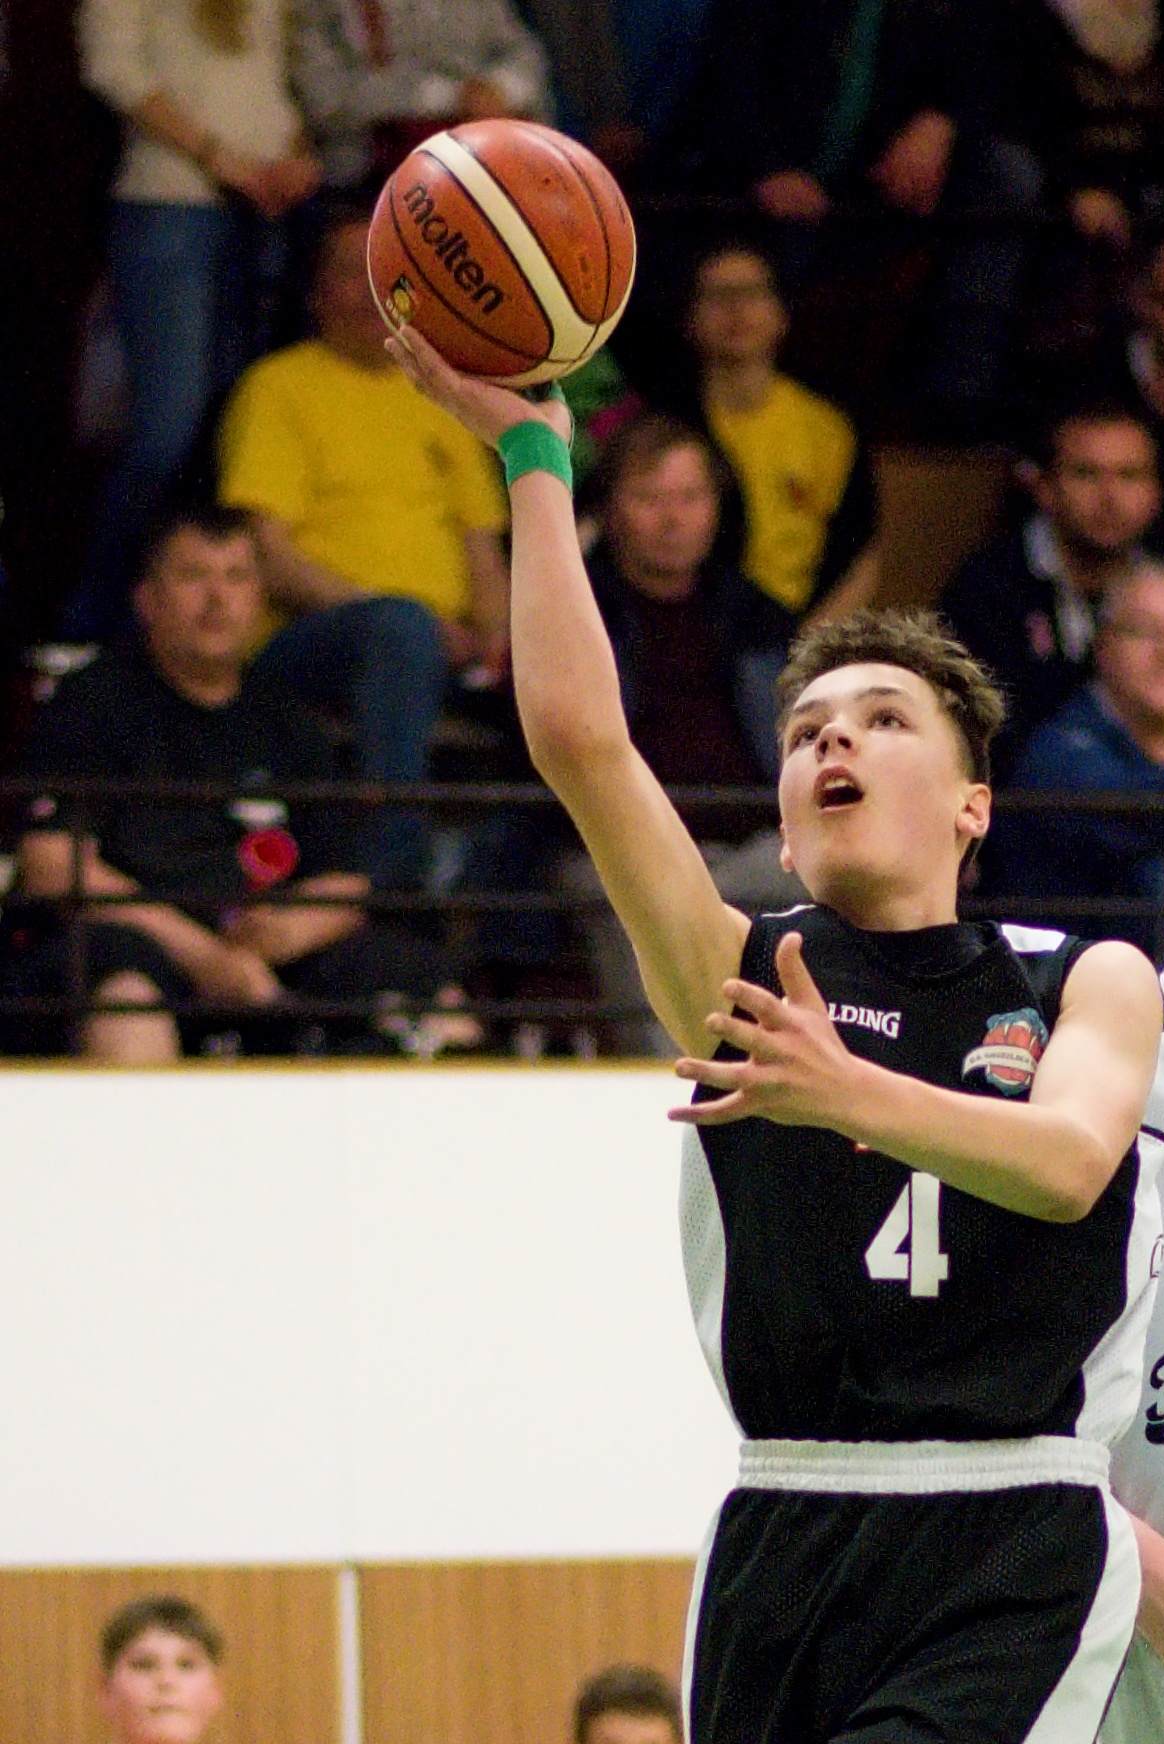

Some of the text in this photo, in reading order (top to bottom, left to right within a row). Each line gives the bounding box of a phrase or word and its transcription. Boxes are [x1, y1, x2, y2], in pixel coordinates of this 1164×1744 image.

[403, 182, 504, 316] molten
[828, 1003, 901, 1039] LDING
[864, 1171, 949, 1298] 4
